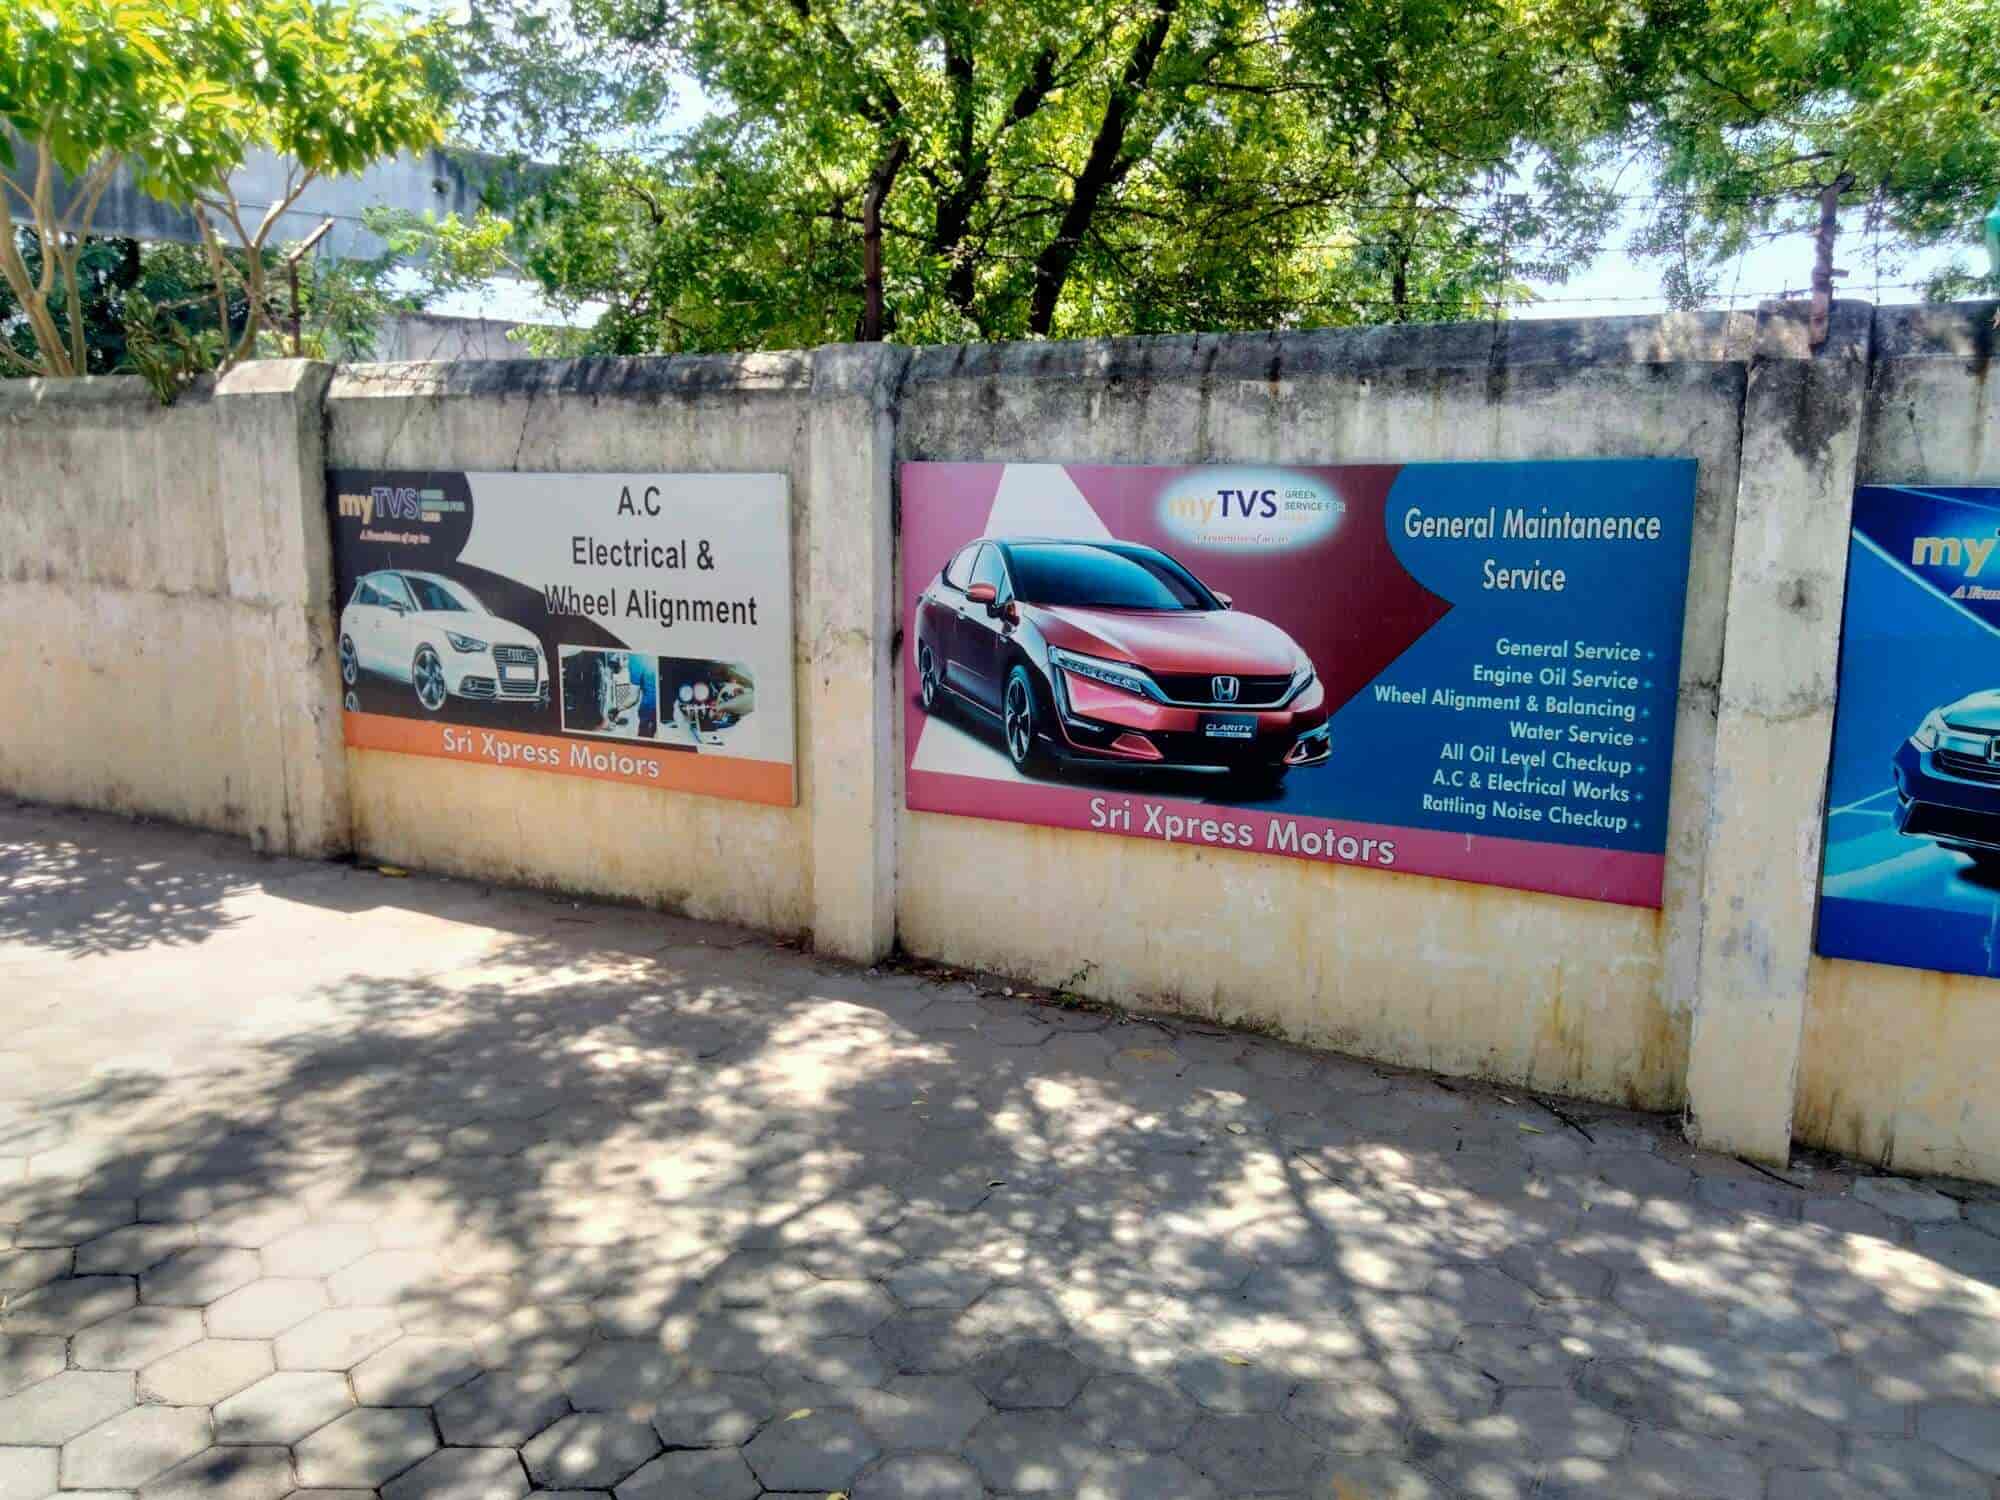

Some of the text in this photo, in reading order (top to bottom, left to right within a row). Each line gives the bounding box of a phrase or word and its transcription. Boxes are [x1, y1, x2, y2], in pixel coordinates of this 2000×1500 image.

[338, 487, 418, 525] myTVS
[617, 486, 661, 516] A.C
[1168, 489, 1278, 527] myTVS
[1284, 501, 1322, 512] SERVICE
[1285, 490, 1317, 499] GREEN
[1403, 507, 1662, 541] General Maintanence
[571, 536, 715, 570] Electrical &
[1482, 558, 1567, 591] Service
[544, 584, 758, 627] Wheel Alignment
[1495, 637, 1641, 662] General Service
[1473, 664, 1638, 690] Engine Oil Service
[1374, 685, 1637, 722] Wheel Alignment & Balancing
[1508, 720, 1634, 746] Water Service
[443, 728, 661, 779] Sri Xpress Motors
[1440, 743, 1633, 779] All Oil Level Checkup
[1432, 769, 1630, 803] A.C & Electrical Works
[1422, 793, 1628, 834] Rattling Noise Checkup
[1089, 797, 1396, 866] Sri Xpress Motors
